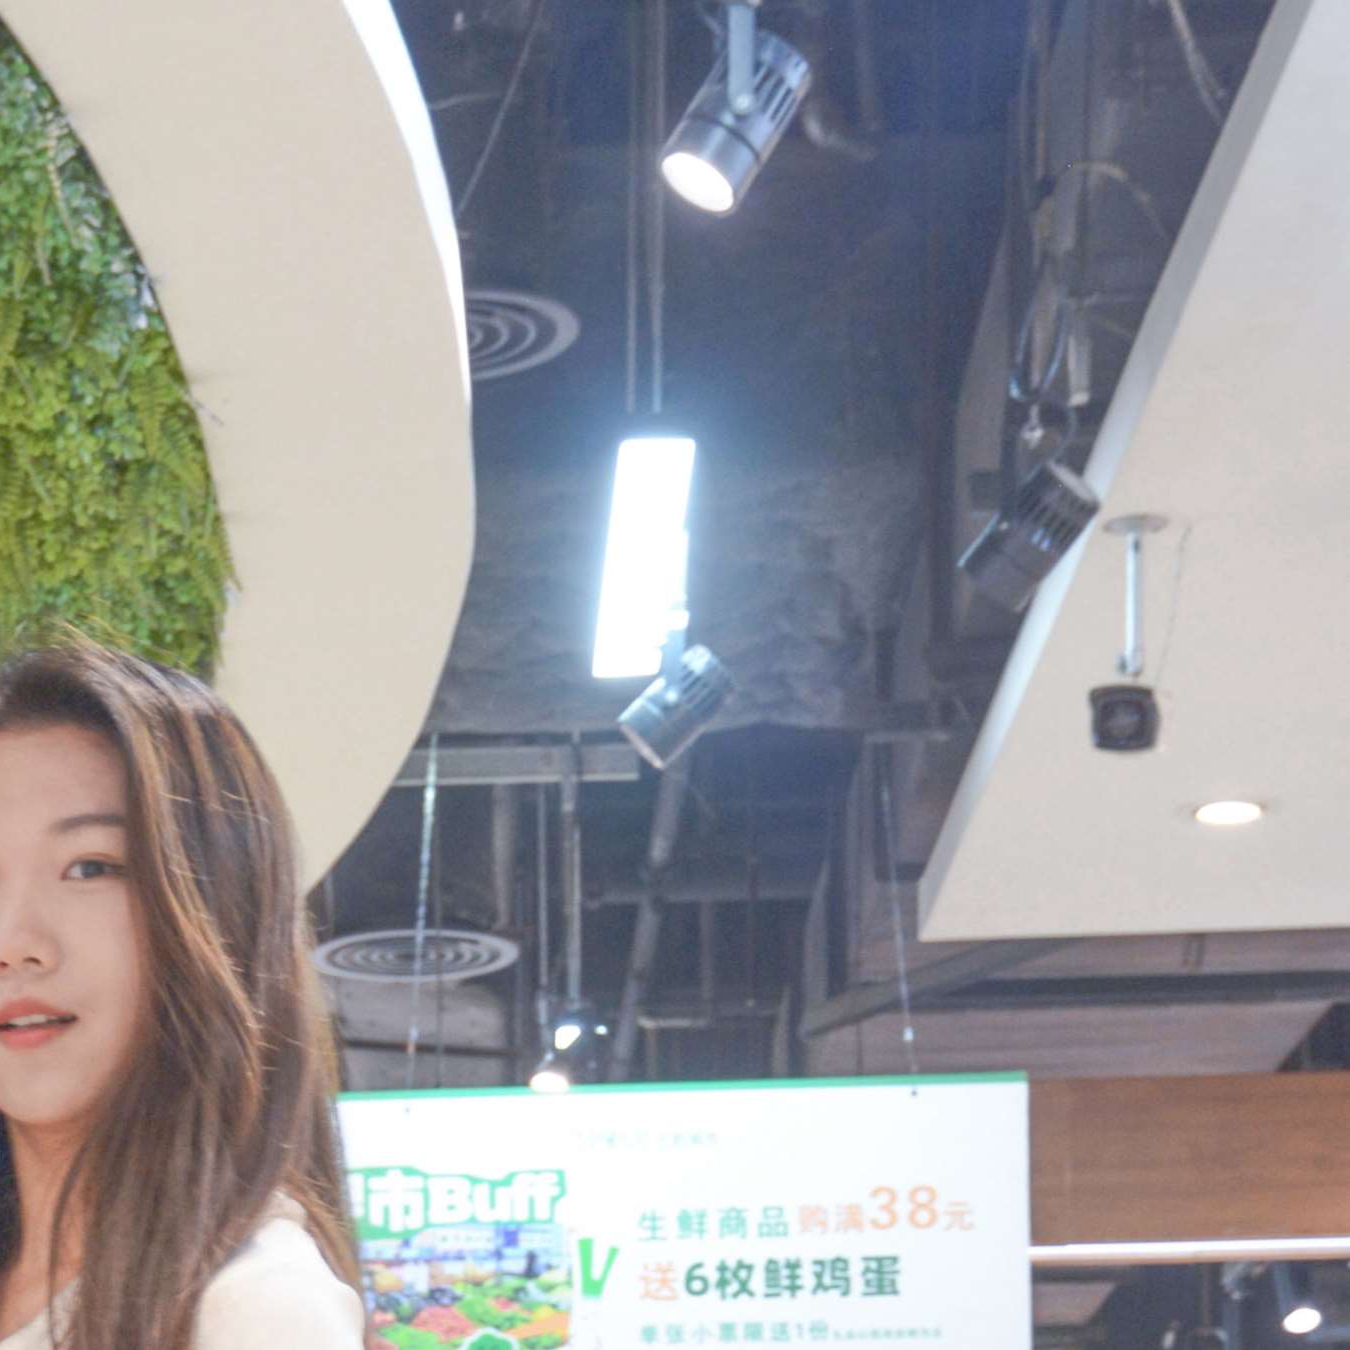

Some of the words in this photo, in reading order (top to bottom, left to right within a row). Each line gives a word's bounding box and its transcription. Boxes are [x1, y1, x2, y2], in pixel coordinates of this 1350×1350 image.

[347, 1169, 560, 1233] 市Buff
[637, 1184, 975, 1241] 生鲜商品购满38元
[638, 1255, 901, 1302] 送6枚鲜鸡蛋
